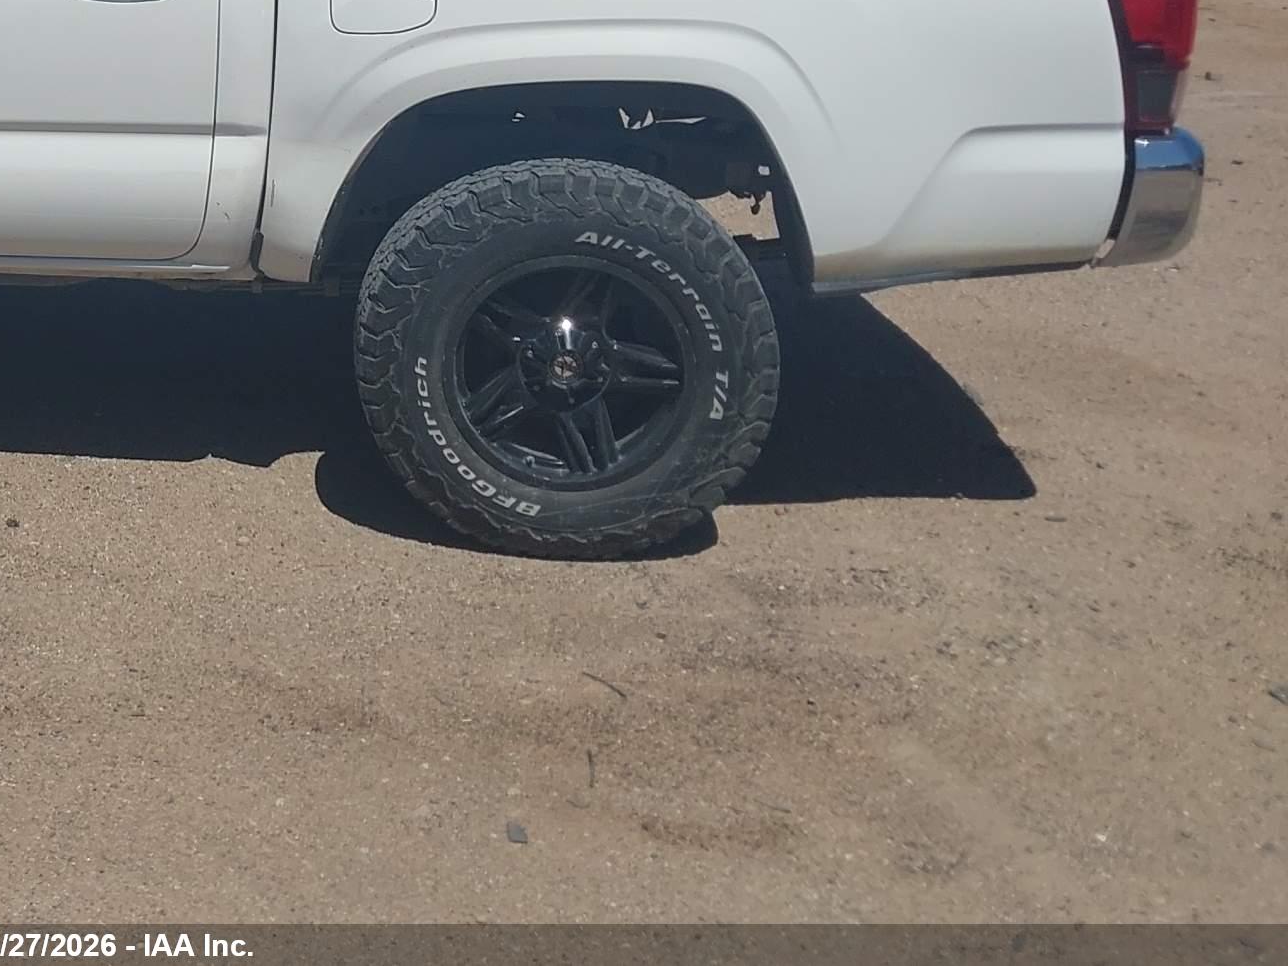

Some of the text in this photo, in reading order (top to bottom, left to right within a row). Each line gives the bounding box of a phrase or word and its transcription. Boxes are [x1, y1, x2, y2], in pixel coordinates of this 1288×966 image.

[574, 231, 729, 420] All-Terrain T/A
[414, 357, 541, 516] BFGoodrich
